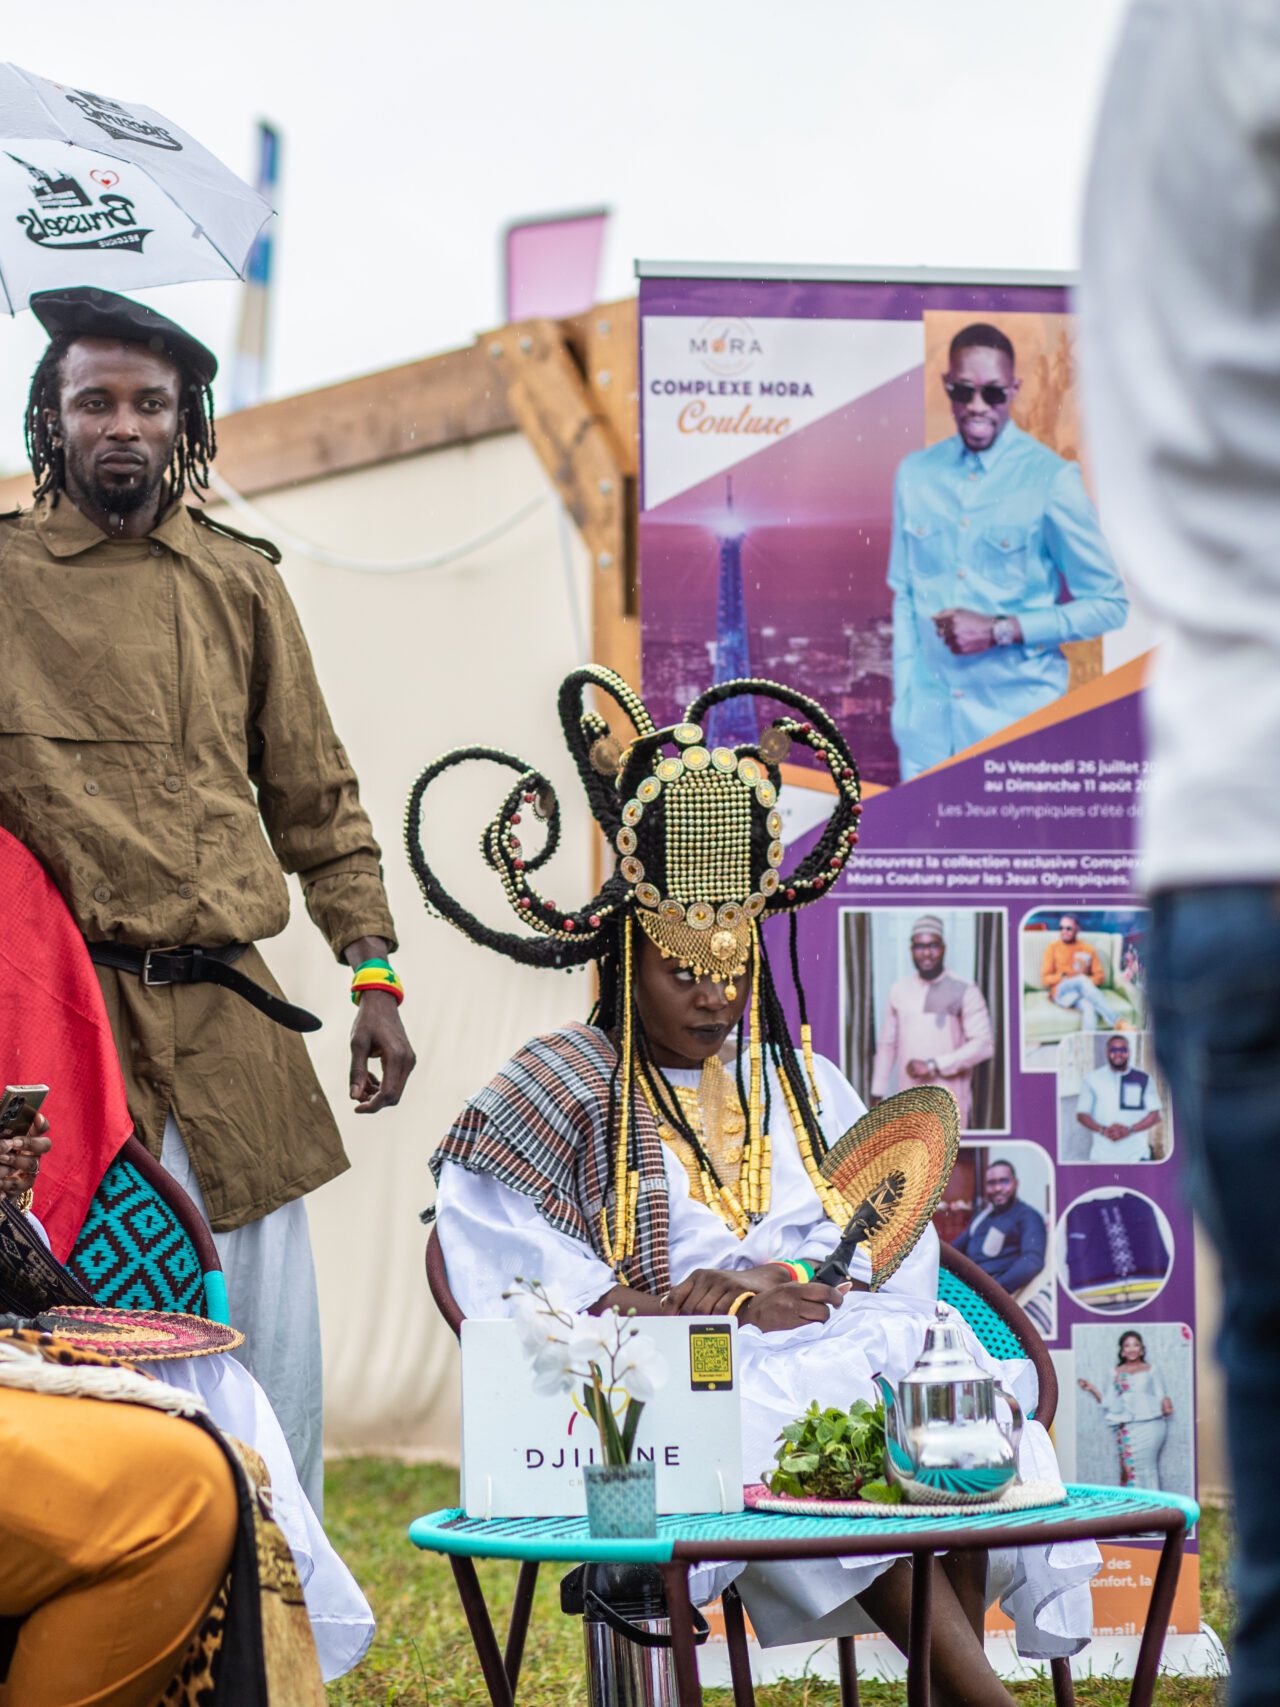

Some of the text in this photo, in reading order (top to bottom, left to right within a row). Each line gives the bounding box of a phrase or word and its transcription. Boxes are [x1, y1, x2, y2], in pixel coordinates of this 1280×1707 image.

[651, 380, 813, 397] COMPLEXE MORA
[677, 399, 791, 435] Couture
[984, 760, 1006, 774] Du
[1007, 759, 1075, 774] Vendredi
[1077, 760, 1096, 774] 26
[1097, 759, 1139, 777] juillet
[984, 780, 1003, 792] au
[1005, 778, 1081, 793] Dimanche
[1083, 779, 1096, 793] 11
[1099, 778, 1132, 793] août
[938, 803, 962, 817] Les
[965, 801, 997, 817] Jeux
[1000, 803, 1086, 820] olympiques
[925, 855, 939, 869] la
[942, 855, 1011, 869] collection
[1013, 855, 1078, 869] exclusive
[846, 871, 1130, 888] Mora Couture pour les Jeux Olympiques.
[1107, 1558, 1131, 1570] des
[1089, 1575, 1153, 1588] onfort, la
